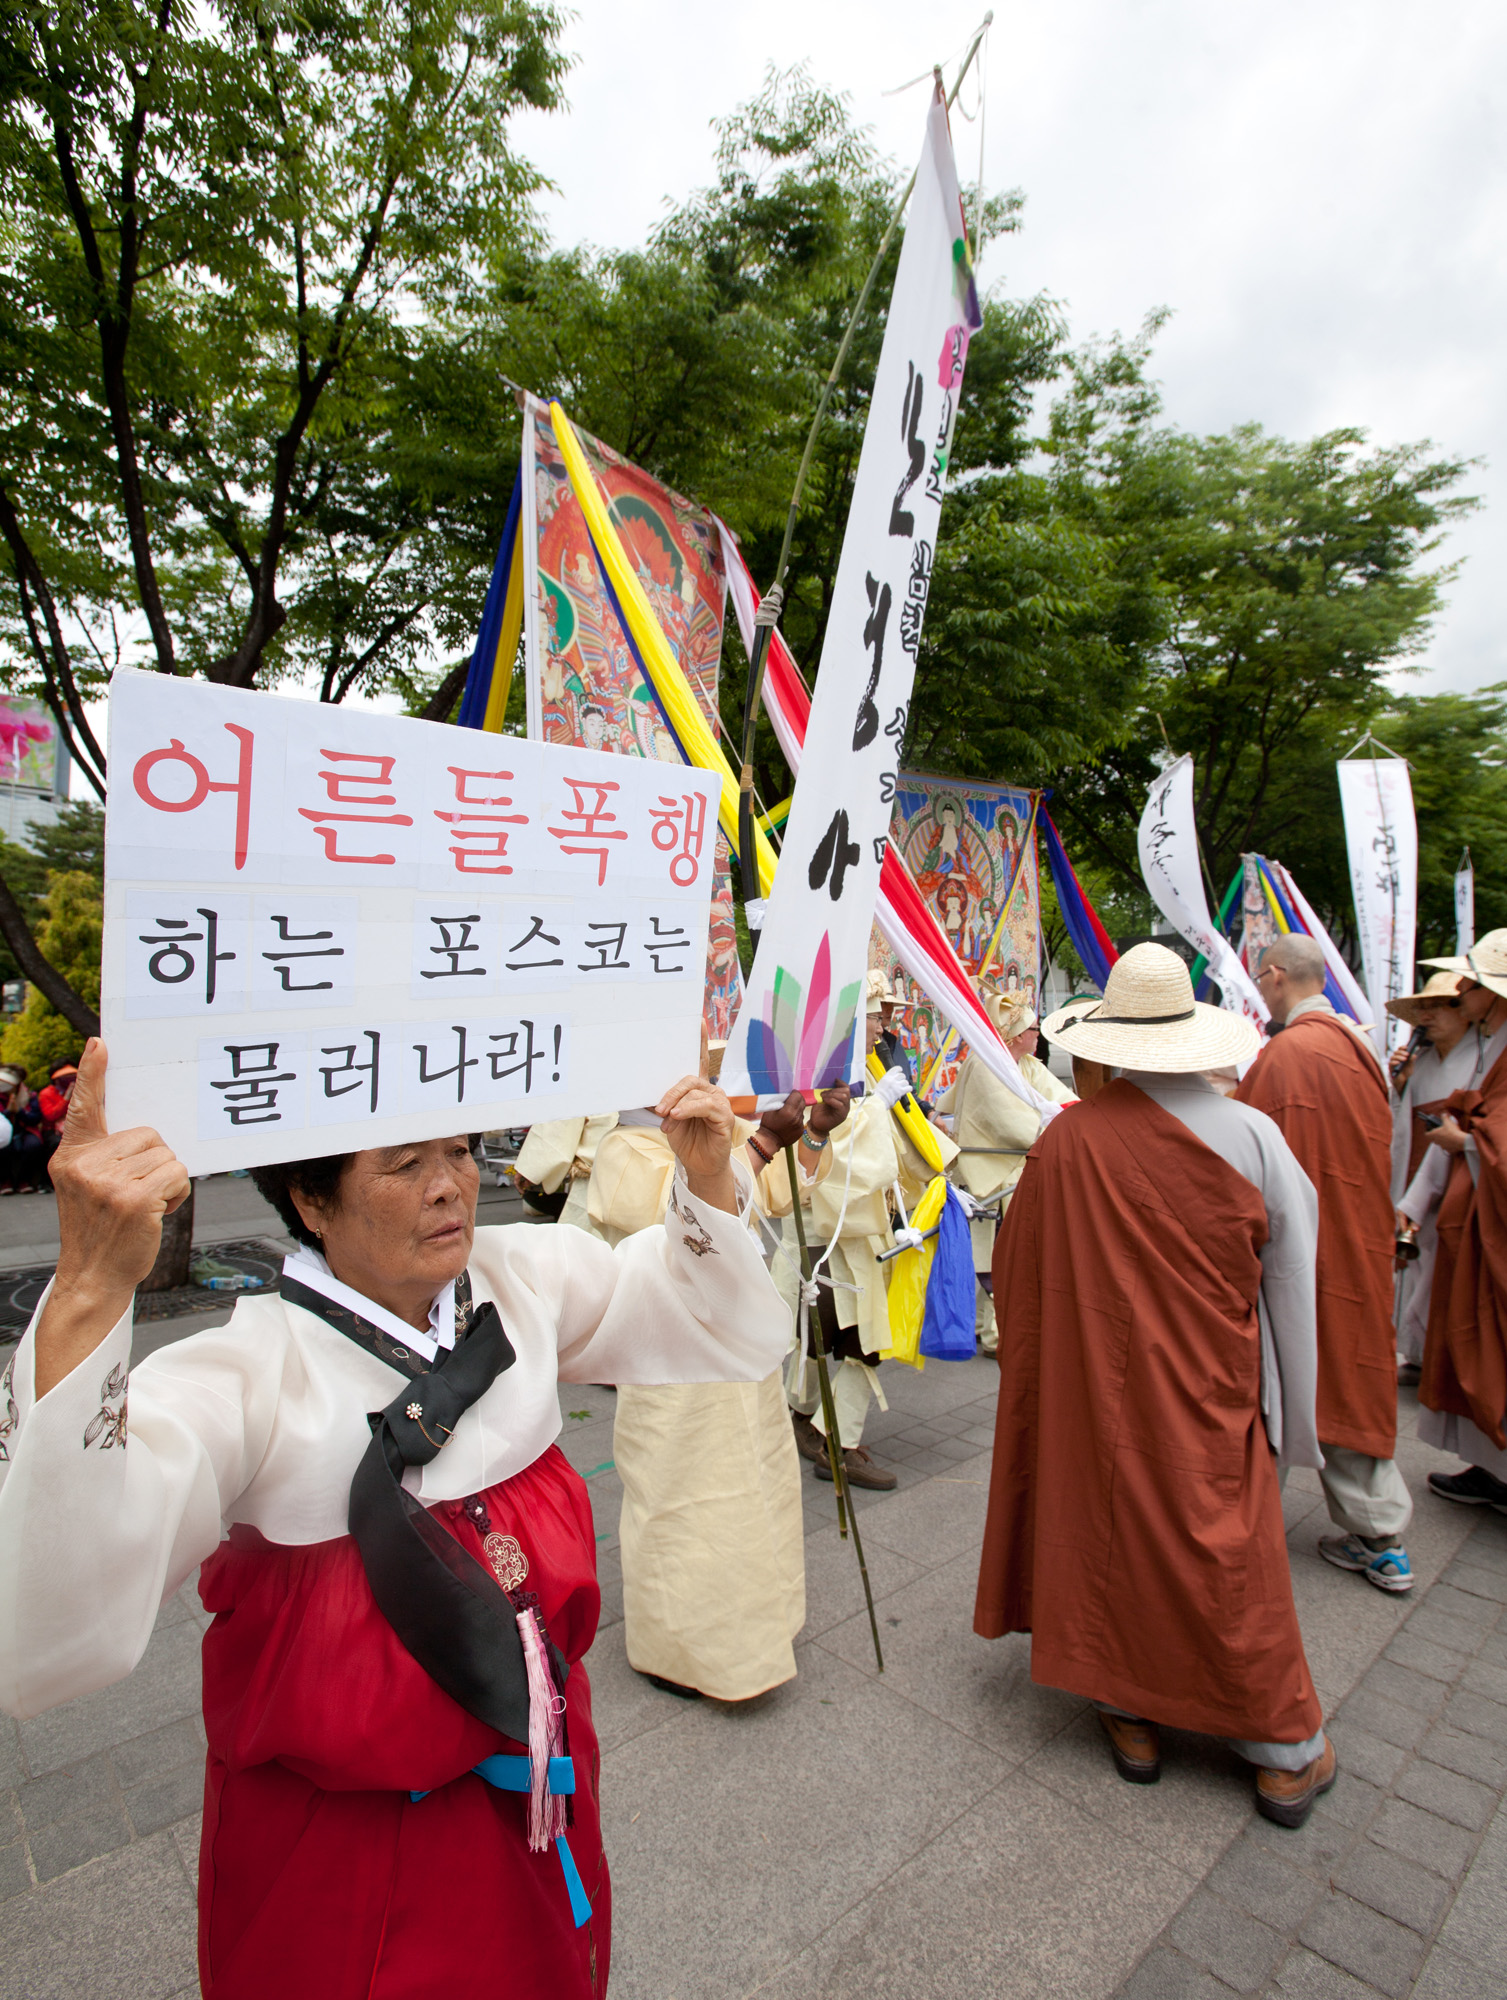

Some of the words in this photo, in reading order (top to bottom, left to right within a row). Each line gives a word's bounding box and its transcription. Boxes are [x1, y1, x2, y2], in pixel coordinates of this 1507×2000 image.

[139, 909, 345, 1004] 하는
[420, 914, 691, 979] 포스코는
[210, 1020, 562, 1126] 물러나라!
